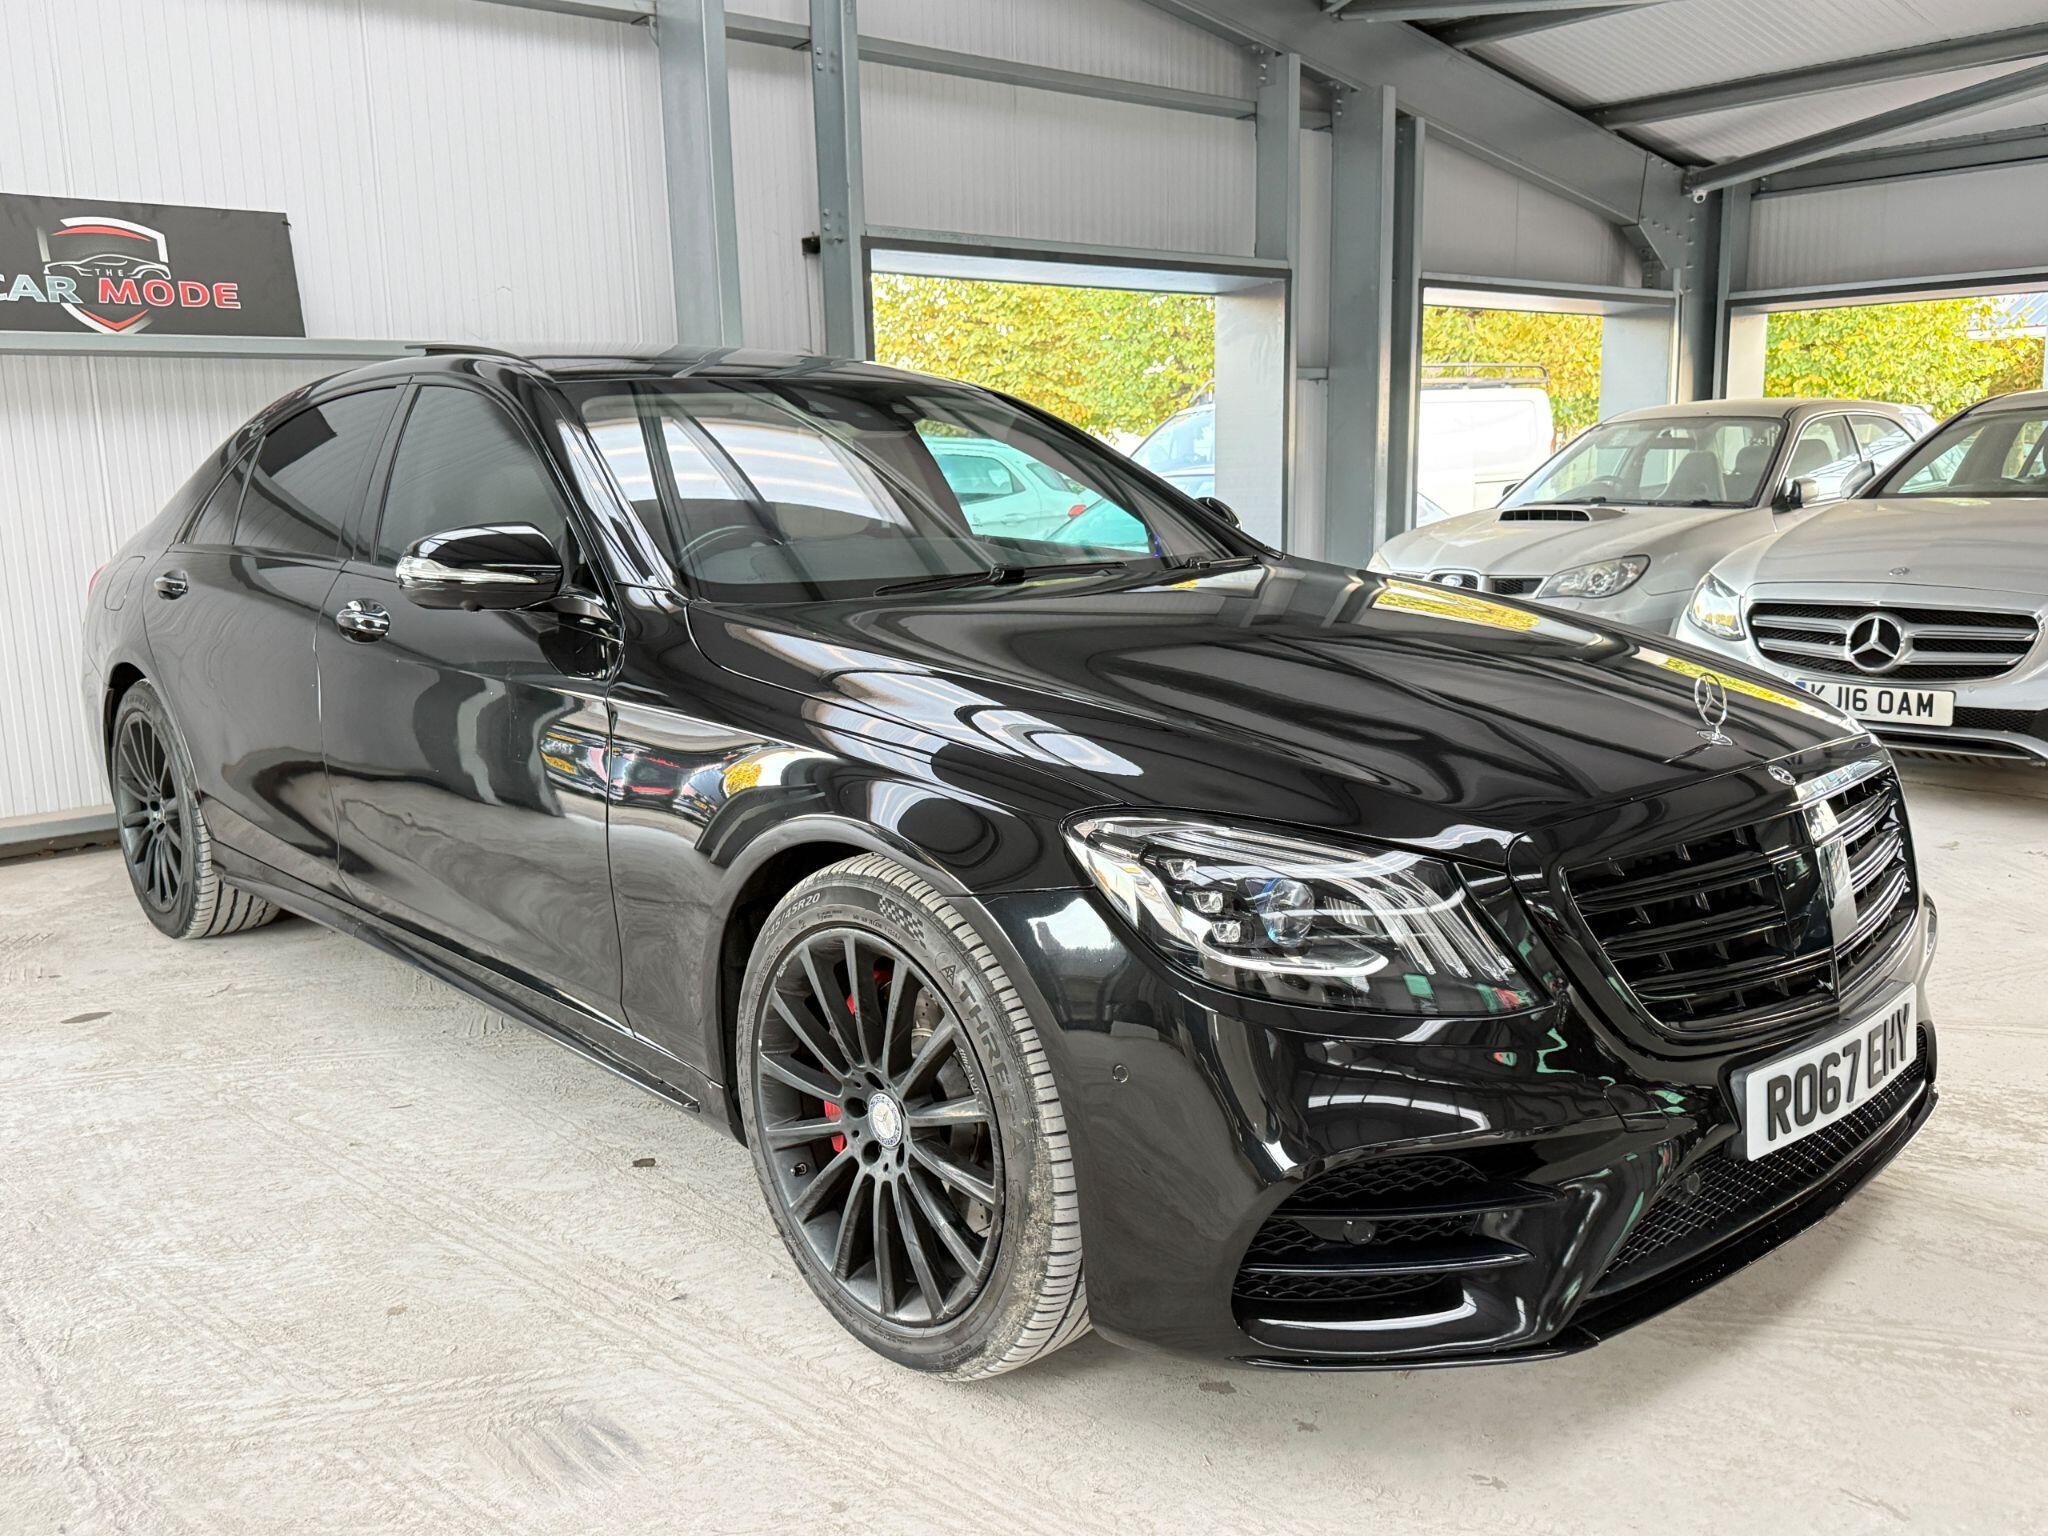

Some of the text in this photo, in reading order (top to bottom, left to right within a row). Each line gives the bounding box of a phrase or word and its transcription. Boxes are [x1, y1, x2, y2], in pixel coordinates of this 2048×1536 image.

[95, 268, 124, 277] THE
[0, 273, 242, 310] AR MODE
[1877, 690, 1934, 718] OAM
[1767, 1002, 1911, 1142] RO67 EHY
